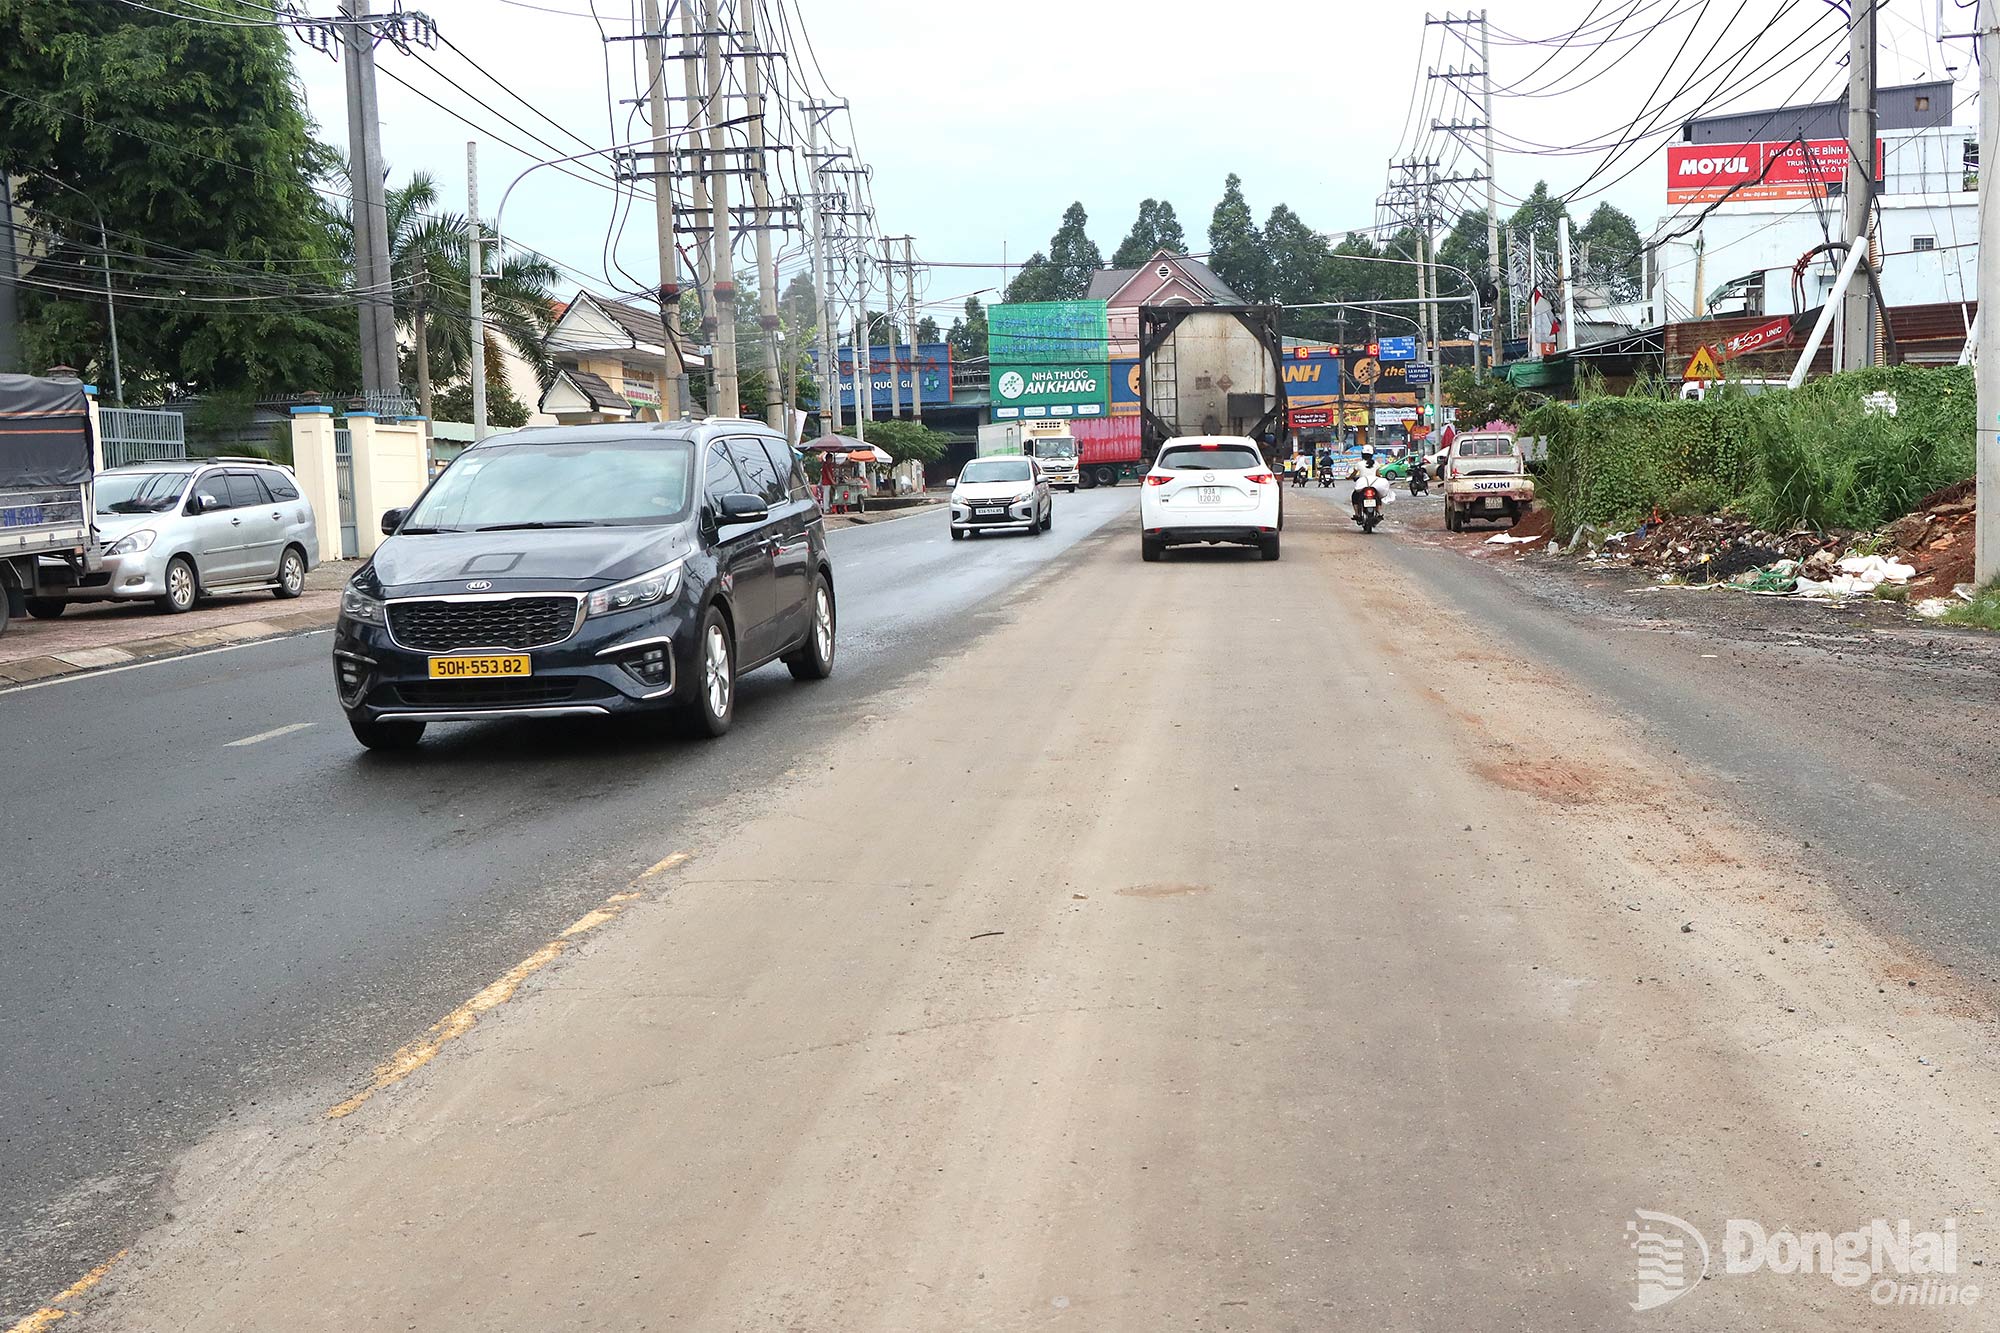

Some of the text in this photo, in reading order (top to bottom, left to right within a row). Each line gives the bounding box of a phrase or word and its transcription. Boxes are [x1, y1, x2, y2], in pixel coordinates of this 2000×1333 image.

[1822, 144, 1844, 155] BÌNH
[1678, 157, 1750, 175] MOTUL
[1766, 326, 1782, 337] UNIC
[1298, 347, 1308, 358] 18
[1032, 368, 1089, 381] NHÀ THUỐC
[874, 379, 893, 391] QUỐ
[1024, 379, 1097, 395] AN KHANG
[1474, 481, 1510, 490] SUZUKI
[468, 581, 488, 590] KIA
[437, 659, 522, 675] 50H-553.82
